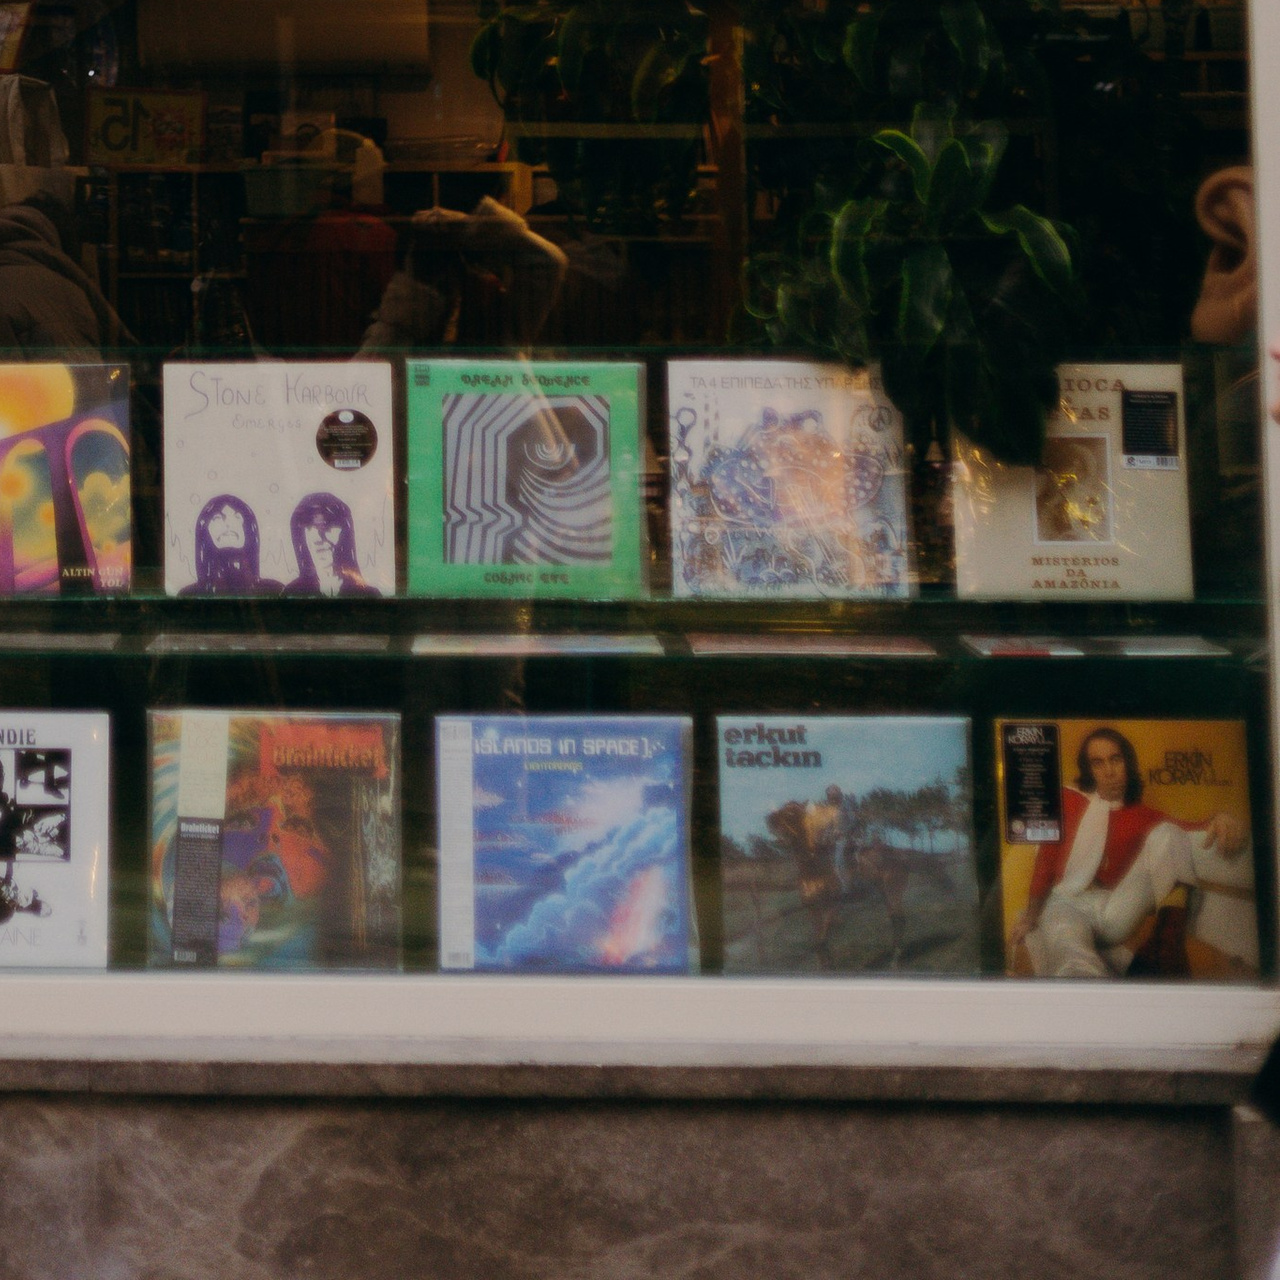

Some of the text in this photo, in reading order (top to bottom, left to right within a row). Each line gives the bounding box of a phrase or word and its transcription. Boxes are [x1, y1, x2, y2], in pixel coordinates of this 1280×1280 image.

[1063, 378, 1125, 392] IOCA
[62, 568, 95, 577] ALTIN
[1066, 568, 1087, 578] DA
[101, 579, 122, 588] YOL
[724, 722, 807, 744] erkut
[474, 738, 552, 756] ISLANDS
[582, 738, 640, 756] SPACE
